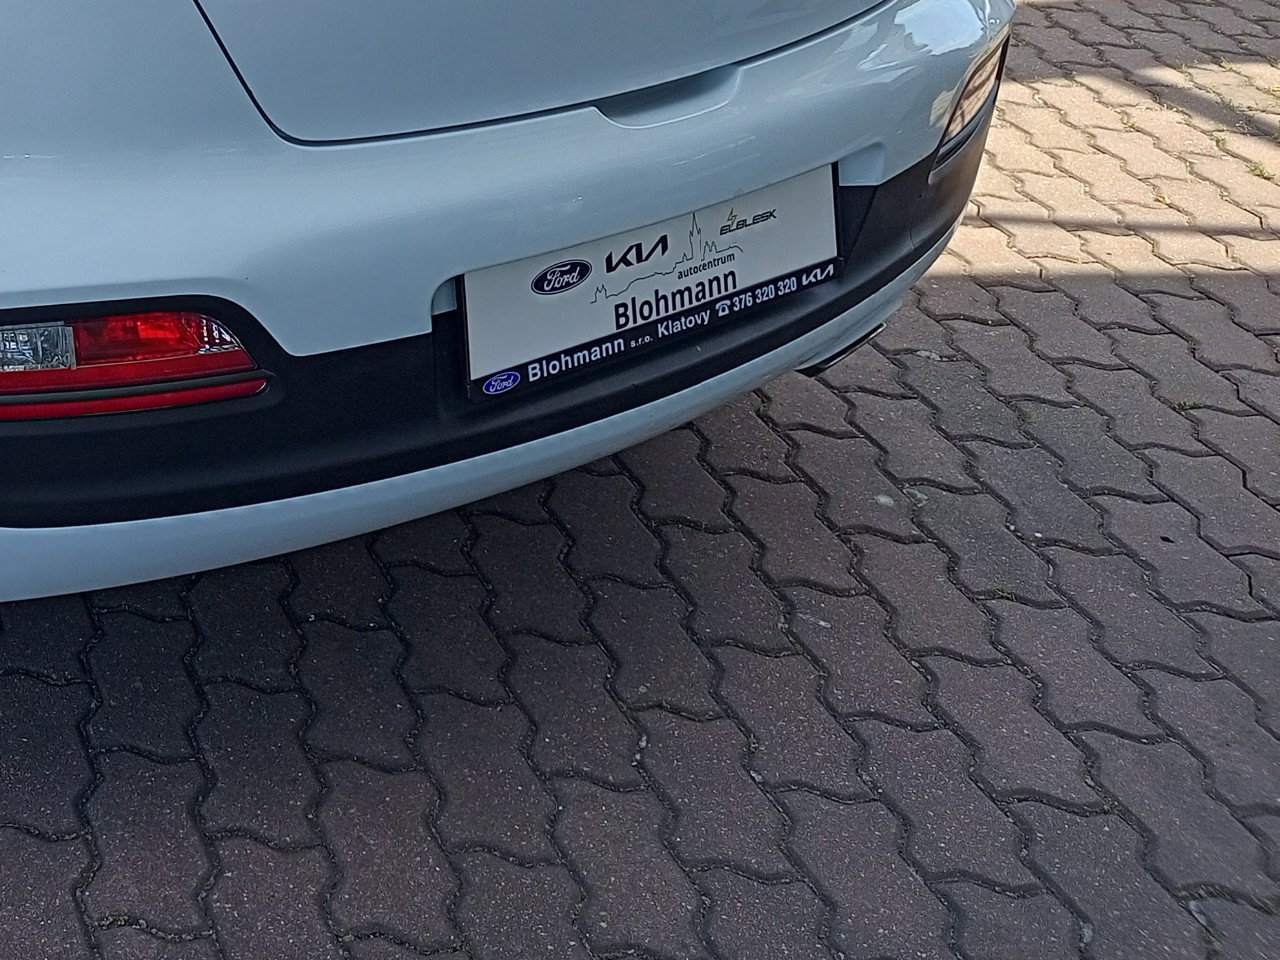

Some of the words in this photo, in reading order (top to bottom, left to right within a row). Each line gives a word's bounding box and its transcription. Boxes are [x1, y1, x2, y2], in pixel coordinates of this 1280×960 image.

[605, 234, 669, 274] KIA
[677, 252, 736, 280] autocentrum
[543, 264, 581, 291] Ford
[614, 269, 737, 330] Blohmann
[528, 338, 625, 382] Blohmann
[630, 334, 654, 348] s.r.o.
[657, 309, 711, 338] Klatovy
[732, 292, 753, 312] 376
[755, 284, 775, 304] 320
[777, 277, 797, 296] 320
[801, 264, 834, 286] KIA
